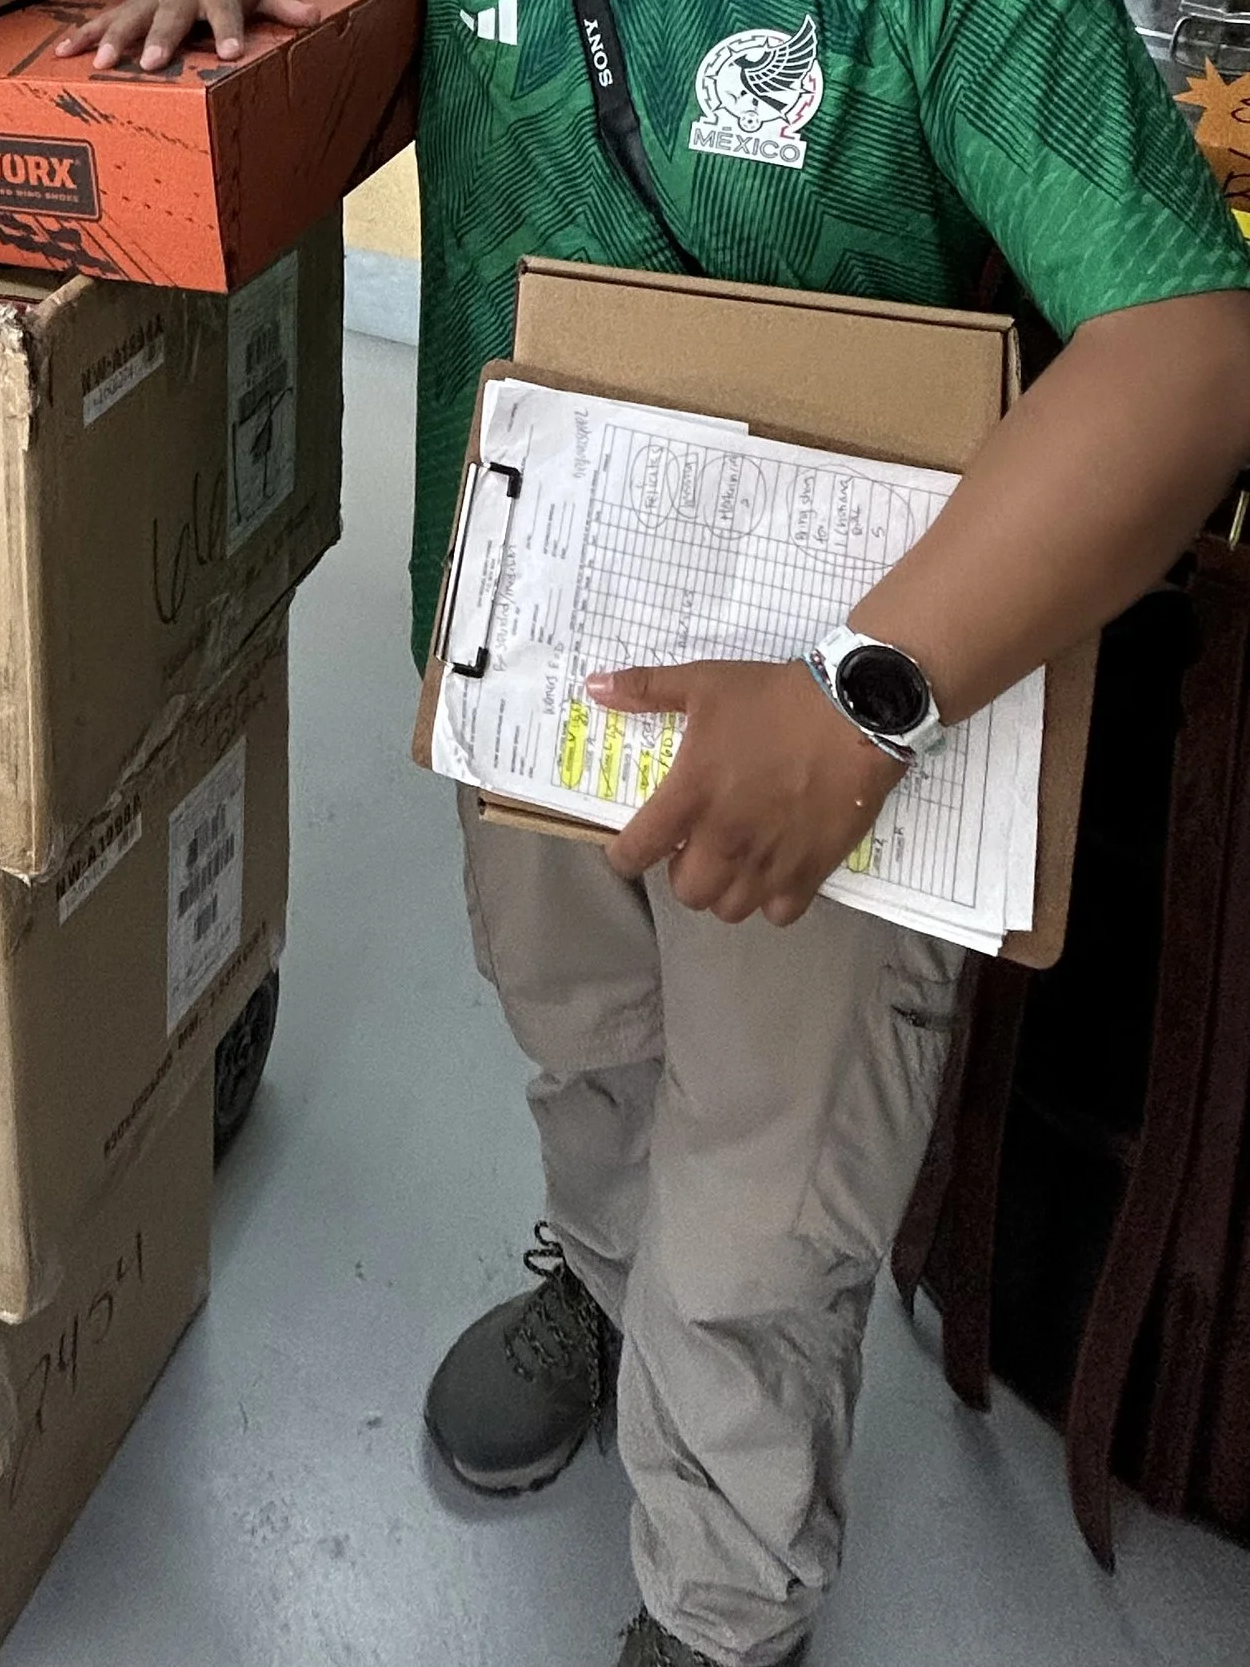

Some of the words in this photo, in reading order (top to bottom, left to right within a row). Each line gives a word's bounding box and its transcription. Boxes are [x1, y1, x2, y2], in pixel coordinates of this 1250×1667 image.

[583, 18, 613, 88] SONY
[692, 125, 801, 164] MÉXICO
[16, 189, 41, 199] WING
[45, 192, 79, 203] SHOES
